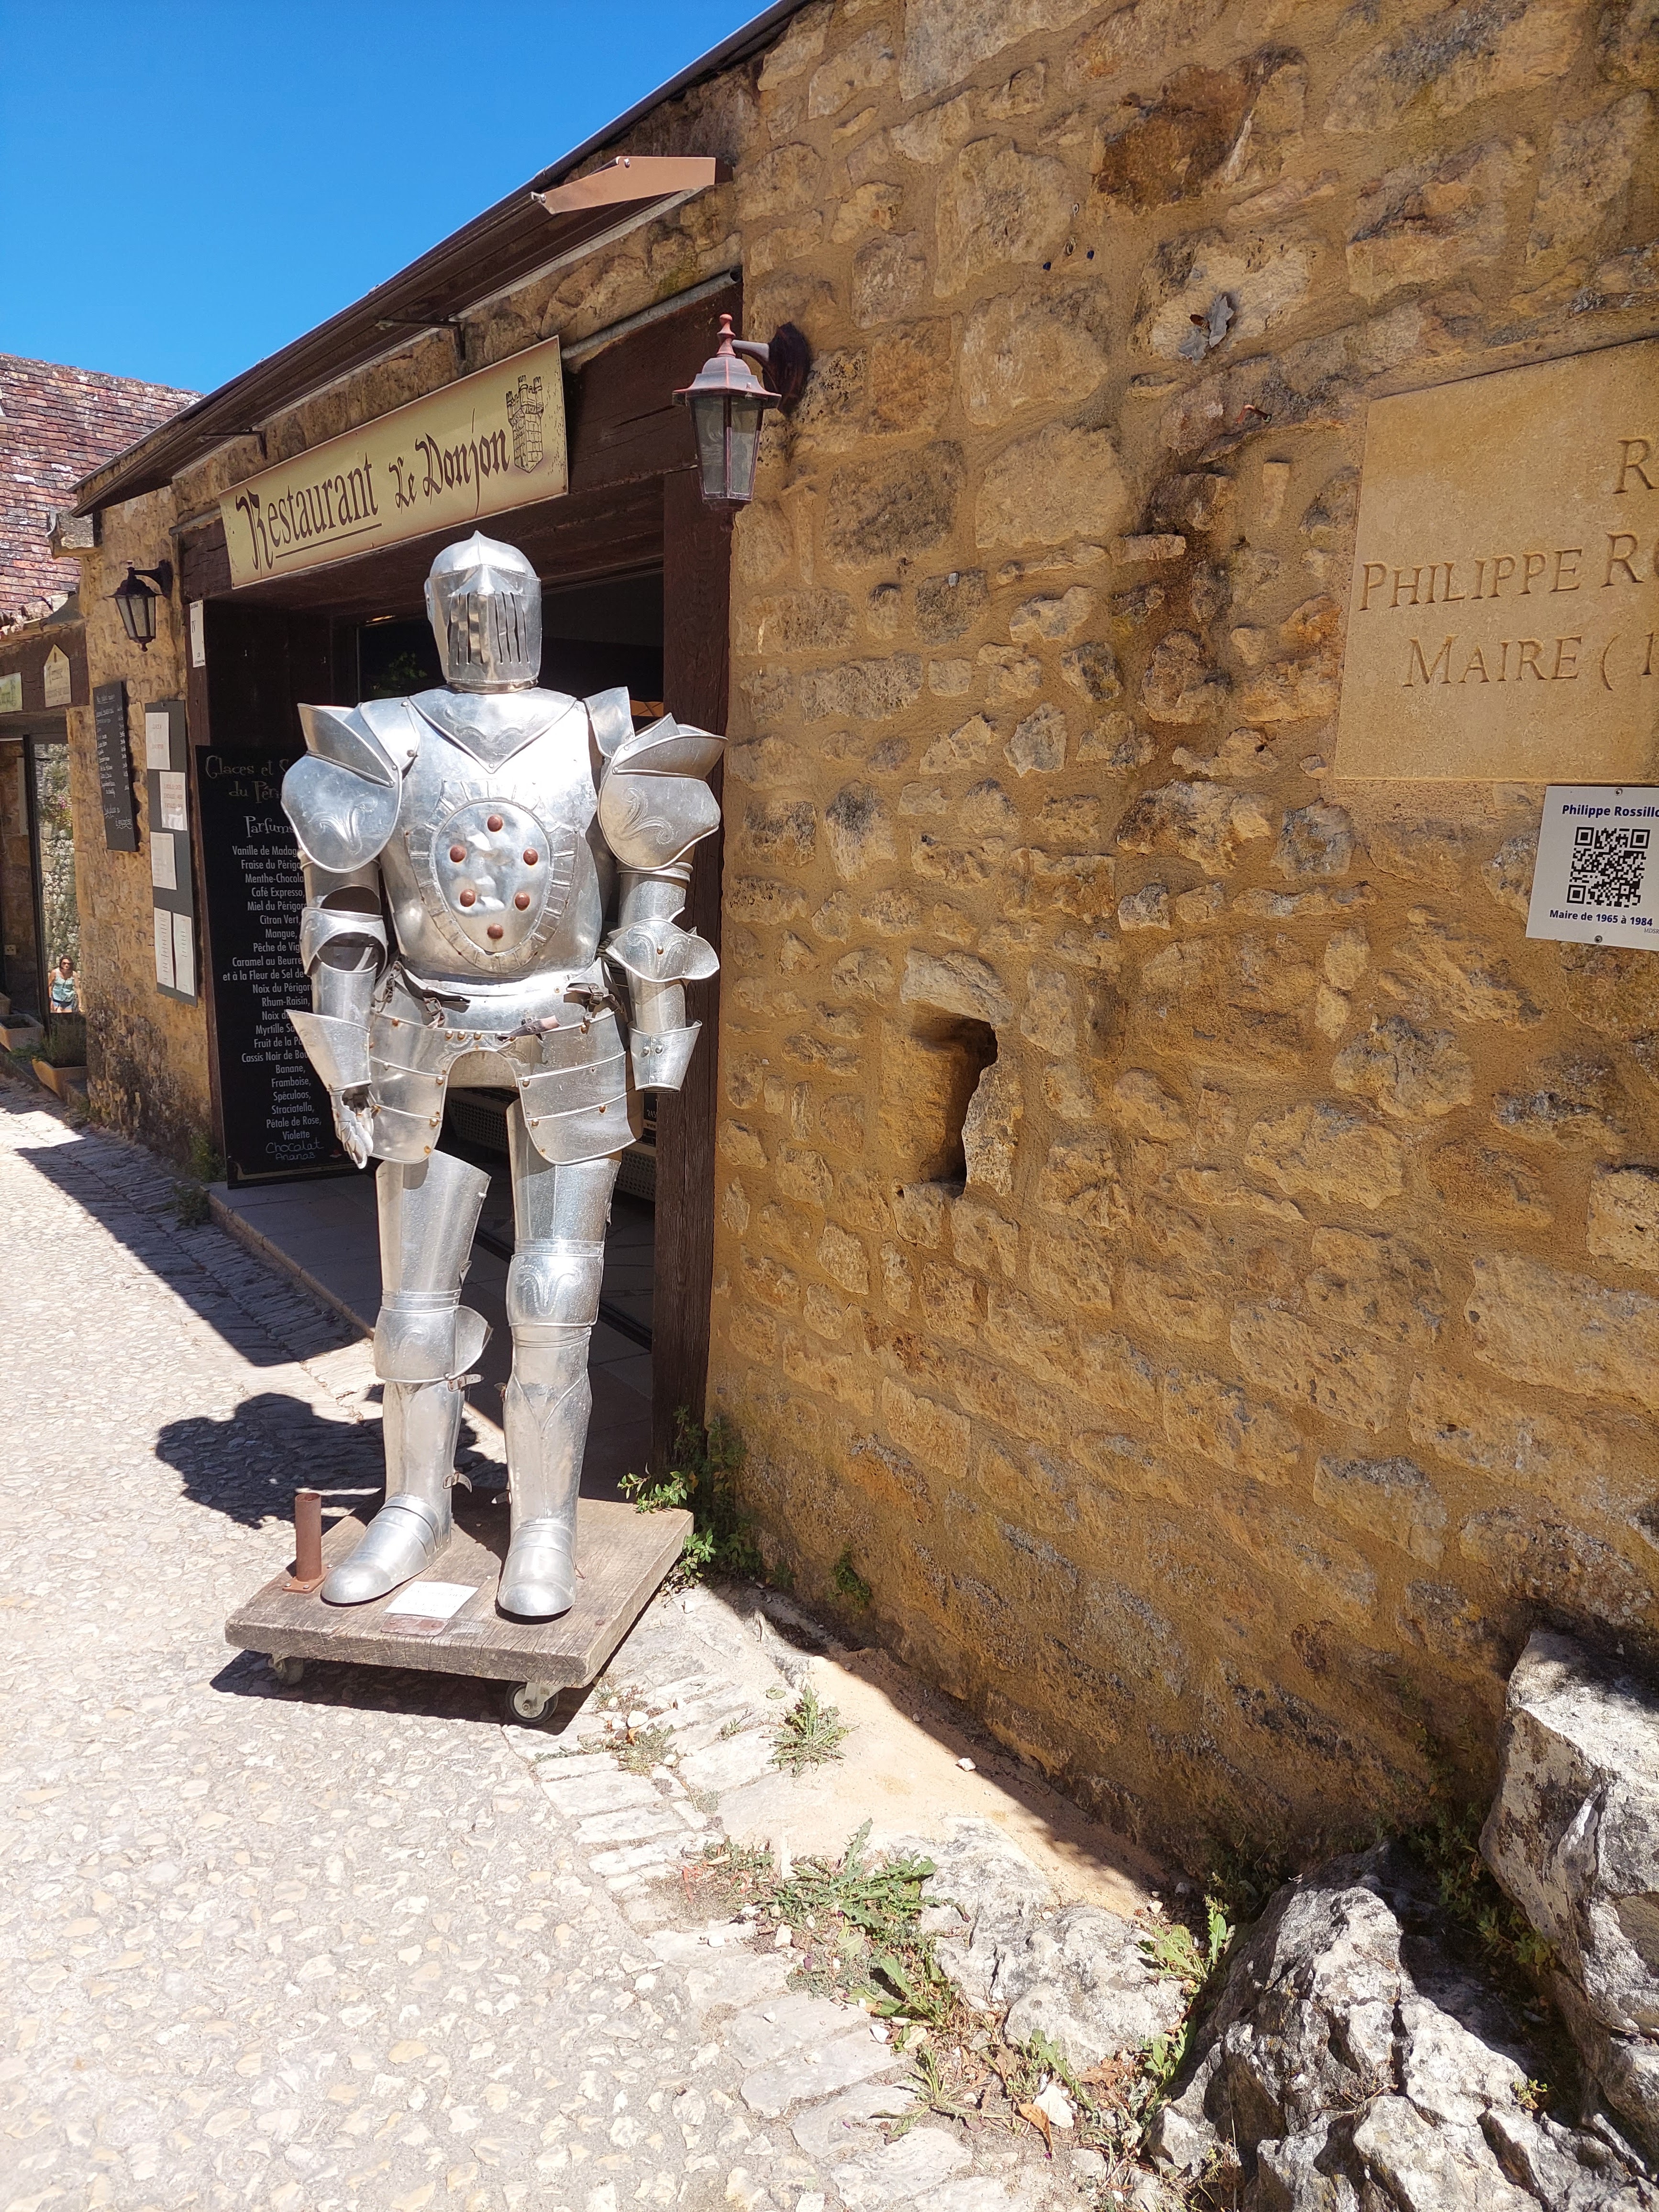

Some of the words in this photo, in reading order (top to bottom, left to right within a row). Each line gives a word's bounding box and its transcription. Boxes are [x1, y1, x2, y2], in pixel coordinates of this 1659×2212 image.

[236, 453, 379, 575] Restaurant
[388, 456, 417, 515] Le
[415, 408, 510, 517] Donjon
[1359, 548, 1582, 611] PHILIPPE
[1600, 532, 1659, 588] R
[1403, 635, 1582, 688] MAIRE
[261, 760, 274, 776] et
[229, 781, 249, 797] du
[252, 781, 282, 804] Péri
[1562, 804, 1611, 818] Philippe
[243, 816, 295, 838] Parfums
[232, 845, 258, 855] Vanille
[260, 845, 270, 855] de
[272, 845, 298, 858] Madag
[241, 859, 264, 869] Fraise
[265, 859, 275, 869] du
[245, 873, 304, 883] Menthe-Chocola
[251, 886, 268, 897] Café
[270, 887, 305, 899] Expresso,
[247, 900, 264, 911] Miel
[265, 900, 275, 910] du
[260, 914, 282, 925] Citron
[283, 914, 301, 925] Vert,
[1549, 909, 1578, 920] Maire
[1581, 912, 1593, 921] de
[1596, 913, 1618, 923] 1965
[1620, 915, 1627, 924] à
[1630, 917, 1653, 926] 1984
[265, 929, 298, 940] Mangue,
[253, 941, 275, 952] Pêche
[277, 941, 287, 951] de
[288, 942, 300, 953] Vig
[232, 955, 264, 967] Caramel
[277, 956, 302, 965] Beurre
[222, 973, 231, 981] et
[232, 972, 238, 981] à
[240, 970, 247, 980] la
[249, 969, 268, 980] Fleur
[270, 969, 280, 979] de
[281, 968, 293, 979] Sel
[295, 968, 304, 978] de
[253, 984, 270, 994] Noix
[272, 982, 282, 993] du
[262, 996, 310, 1006] Rhum-Raisin,
[262, 1011, 279, 1020] Noix
[256, 1023, 284, 1036] Myrtille
[254, 1039, 271, 1048] Fruit
[273, 1037, 283, 1047] de
[285, 1036, 292, 1046] la
[242, 1053, 264, 1062] Cassis
[265, 1051, 282, 1061] Noir
[283, 1050, 293, 1060] de
[275, 1064, 306, 1074] Banane,
[271, 1076, 311, 1087] Framboise,
[273, 1089, 311, 1103] Spéculoos,
[271, 1101, 314, 1115] Straciatella,
[266, 1117, 289, 1128] Pétale
[291, 1116, 300, 1126] de
[302, 1116, 322, 1126] Rose,
[282, 1129, 310, 1140] Violette
[265, 1137, 325, 1153] Chocolat
